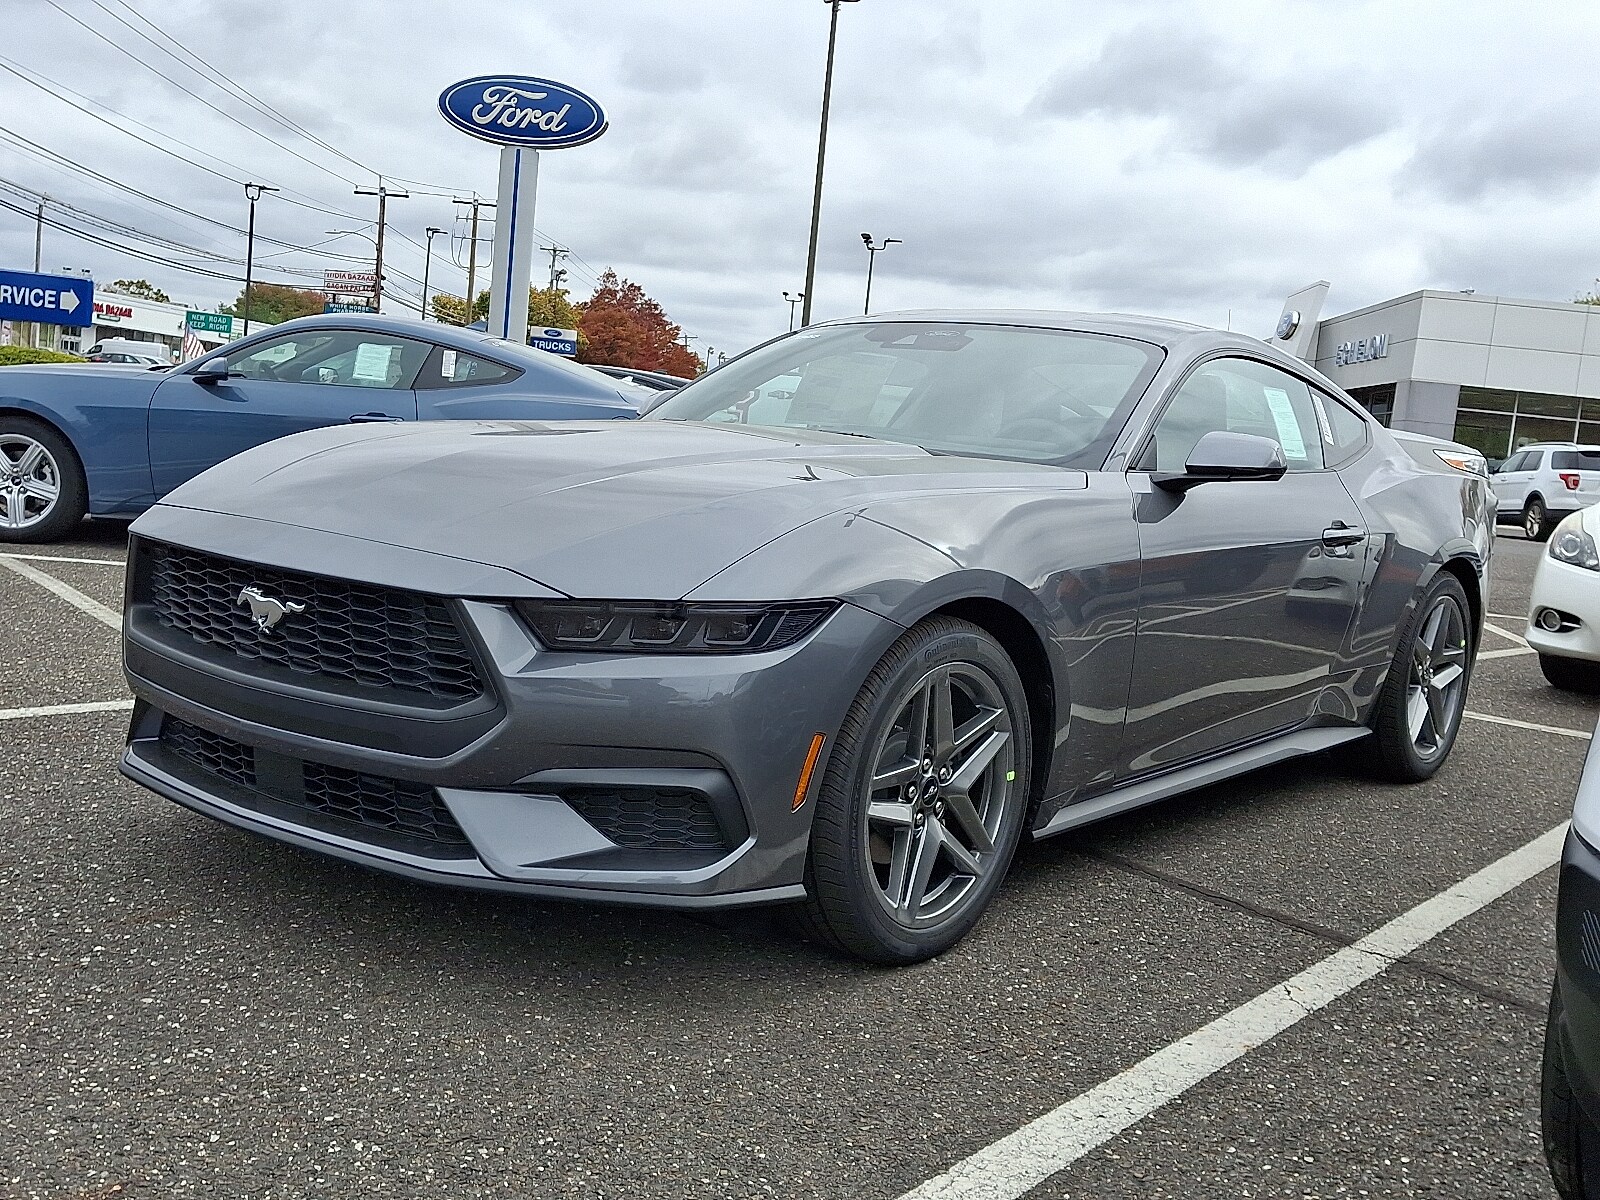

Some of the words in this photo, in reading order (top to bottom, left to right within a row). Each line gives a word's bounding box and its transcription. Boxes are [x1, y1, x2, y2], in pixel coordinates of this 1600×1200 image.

[471, 85, 572, 132] Ford
[0, 284, 57, 309] RVICE
[190, 320, 206, 329] KEEP
[208, 323, 229, 332] RIGHT
[208, 315, 227, 324] ROAD
[533, 339, 572, 352] TRUCKS
